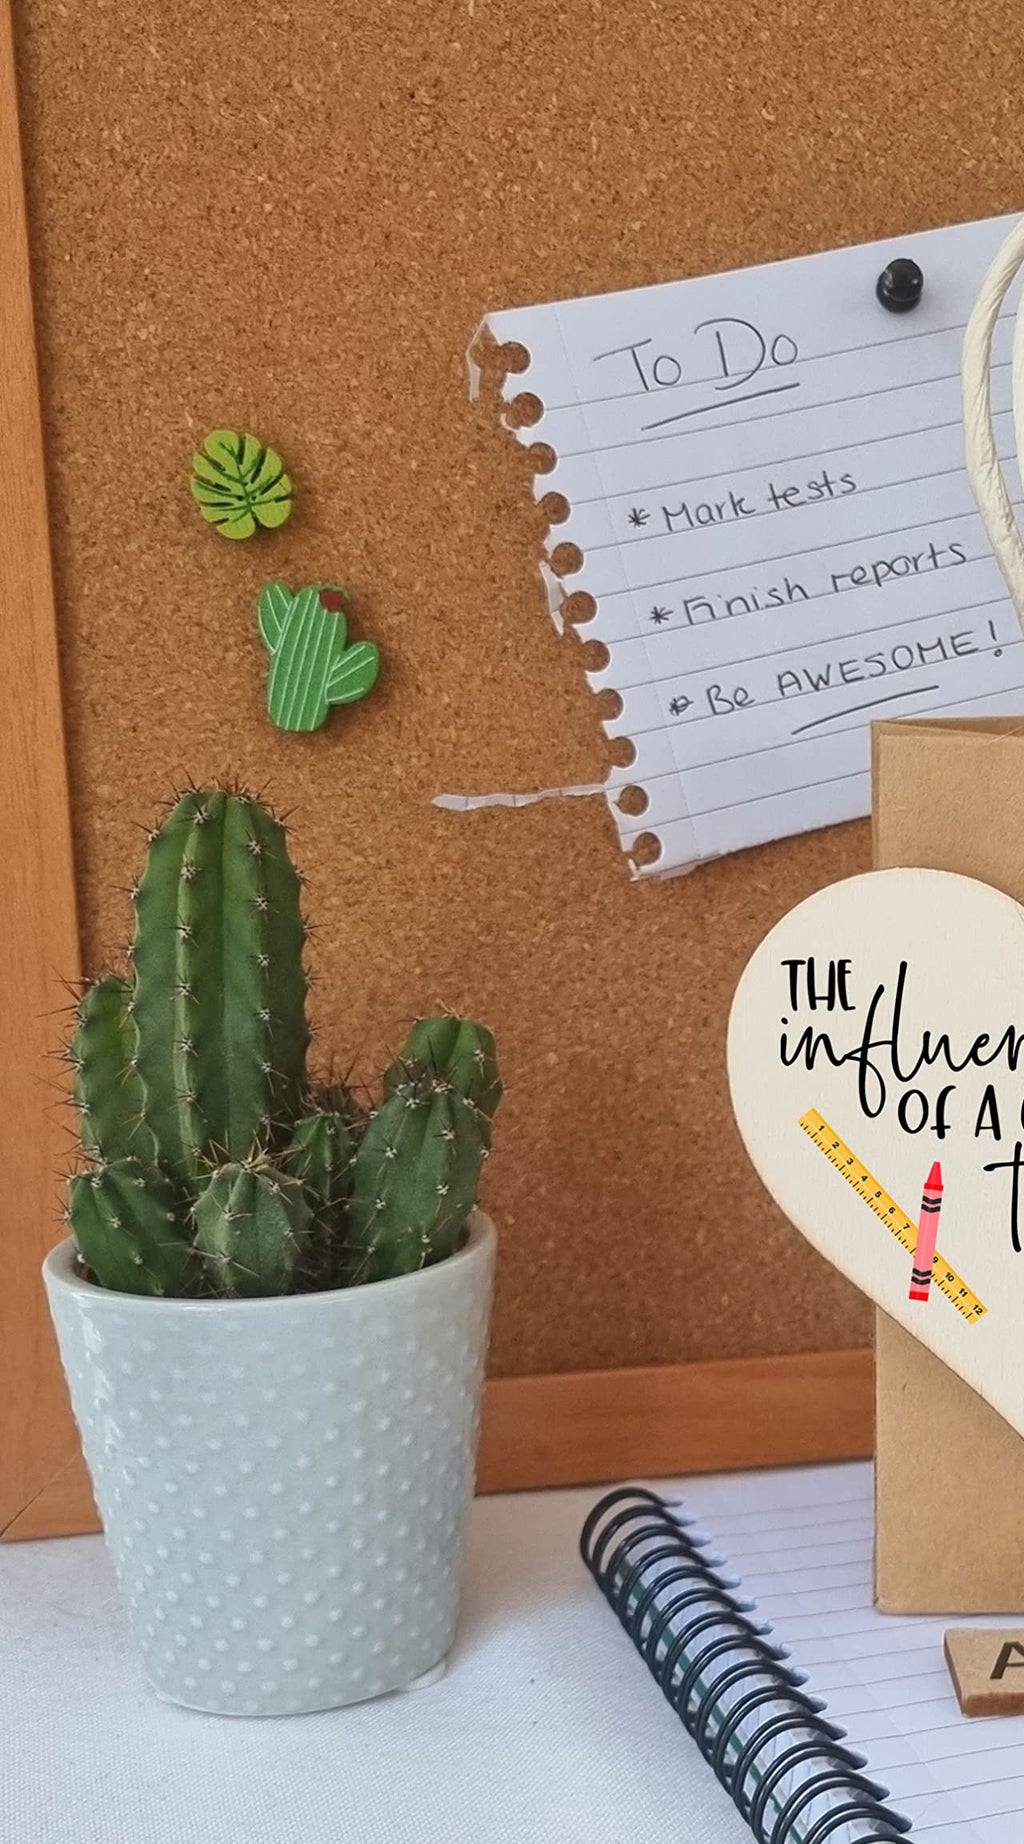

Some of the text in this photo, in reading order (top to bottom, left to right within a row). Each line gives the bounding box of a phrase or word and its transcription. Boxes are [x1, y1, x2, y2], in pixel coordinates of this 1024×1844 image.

[593, 318, 799, 392] To Do
[662, 470, 857, 532] Mark tests
[684, 541, 968, 626] Finish reports
[706, 683, 755, 716] Be
[780, 956, 856, 1012] THE
[897, 1085, 957, 1140] OF
[974, 1084, 1002, 1141] A
[832, 1141, 840, 1149] 2
[945, 1272, 955, 1282] 10
[959, 1288, 968, 1297] 11
[973, 1305, 983, 1315] 12
